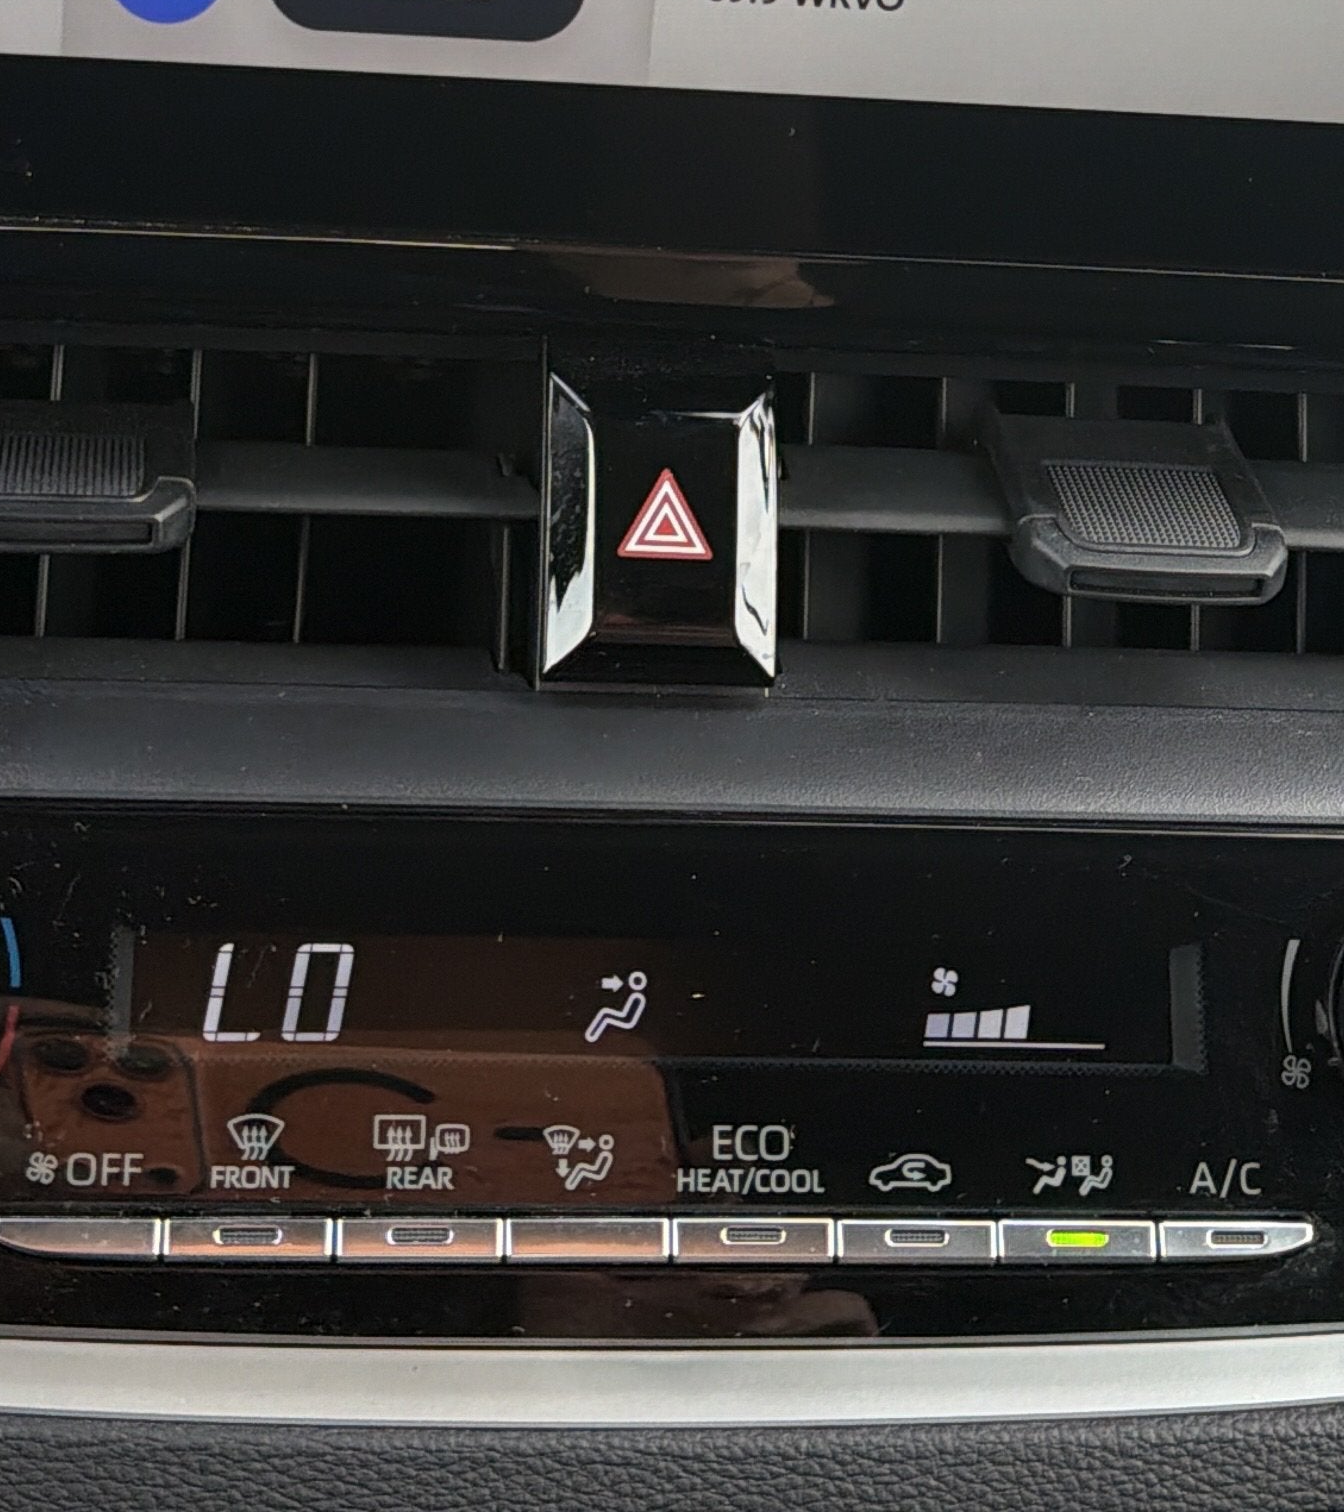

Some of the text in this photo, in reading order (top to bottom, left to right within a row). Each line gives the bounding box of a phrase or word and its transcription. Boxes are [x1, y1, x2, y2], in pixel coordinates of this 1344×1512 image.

[713, 1125, 790, 1162] ECO
[67, 1152, 144, 1187] OFF
[210, 1165, 295, 1189] FRONT
[387, 1166, 454, 1190] REAR
[676, 1168, 825, 1195] HEAT/COOL
[1189, 1159, 1261, 1197] A/C
